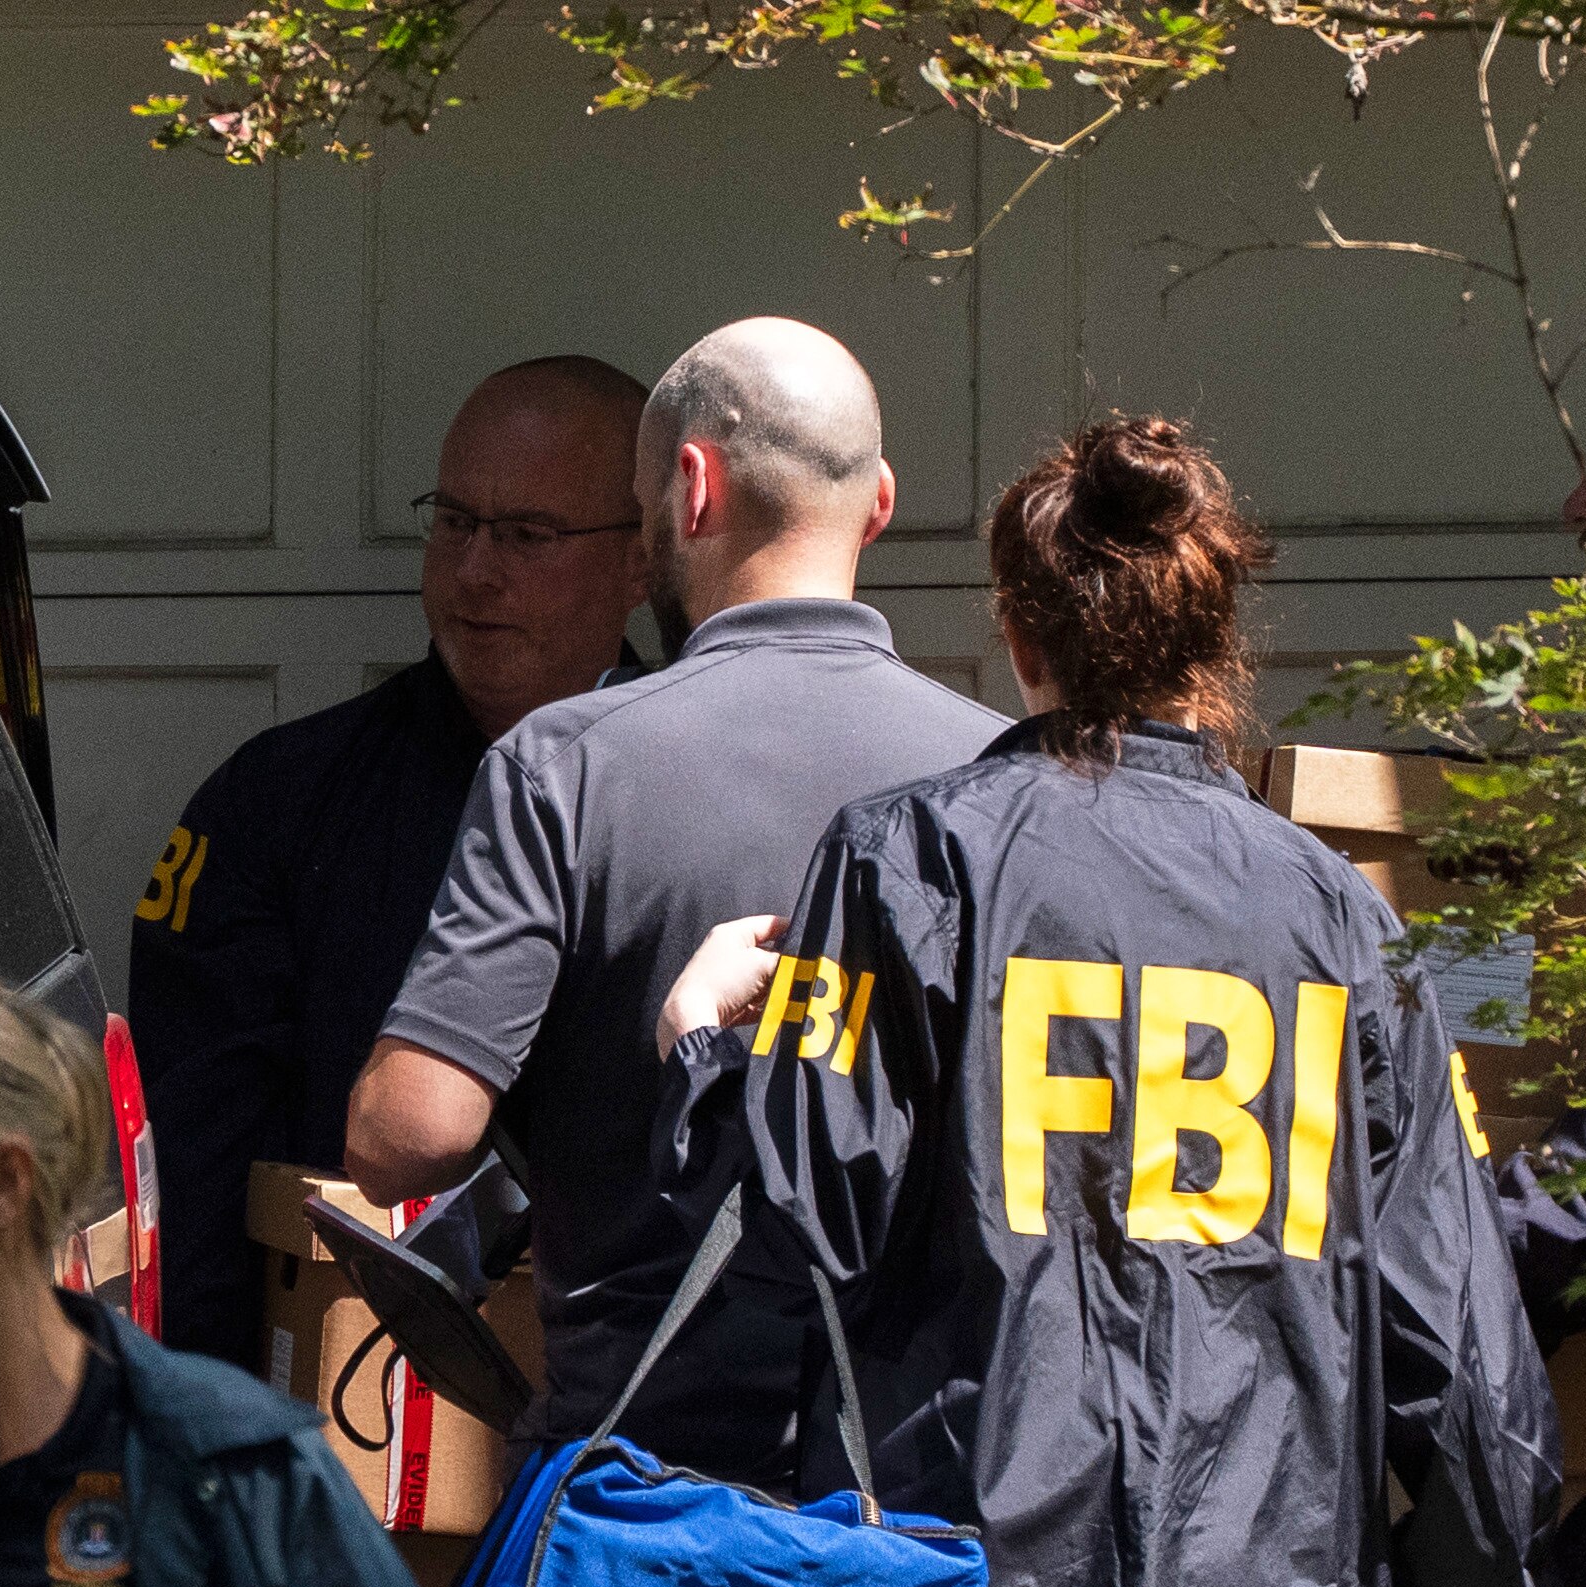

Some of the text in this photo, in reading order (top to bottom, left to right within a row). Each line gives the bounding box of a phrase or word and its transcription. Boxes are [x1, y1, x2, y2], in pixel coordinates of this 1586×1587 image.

[134, 825, 210, 933] BI
[751, 955, 876, 1077] FBI
[1001, 957, 1349, 1261] FBI
[403, 1452, 427, 1530] EVIDE
